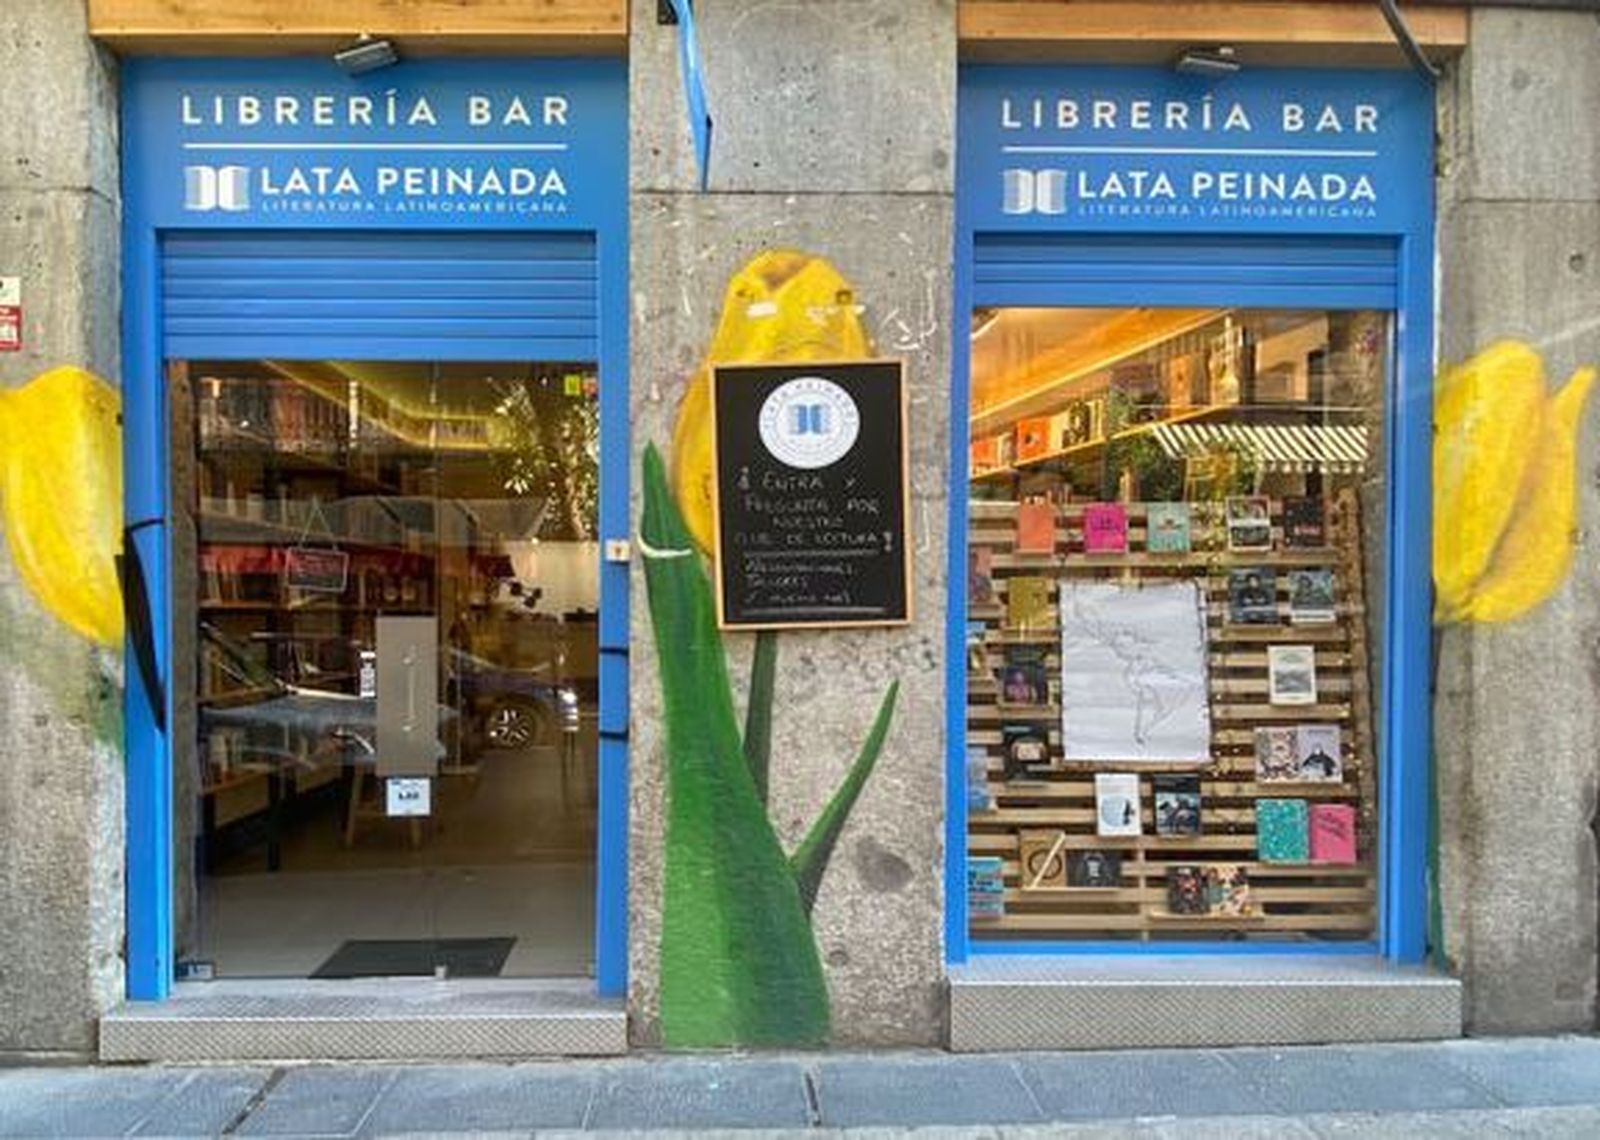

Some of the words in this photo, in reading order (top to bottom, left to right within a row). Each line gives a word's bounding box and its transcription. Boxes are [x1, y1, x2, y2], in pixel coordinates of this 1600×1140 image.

[182, 90, 437, 127] LIBRERÍA
[468, 96, 569, 127] BAR
[1002, 96, 1251, 132] LIBRERÍA
[1282, 103, 1378, 134] BAR
[261, 166, 360, 196] LATA
[377, 167, 567, 197] PEINADA
[1078, 170, 1176, 200] LATA
[1192, 171, 1377, 202] PEINADA
[262, 200, 374, 213] LITERATURA
[384, 200, 567, 214] LATINOAMERICANA
[1079, 204, 1190, 217] LITERATURA
